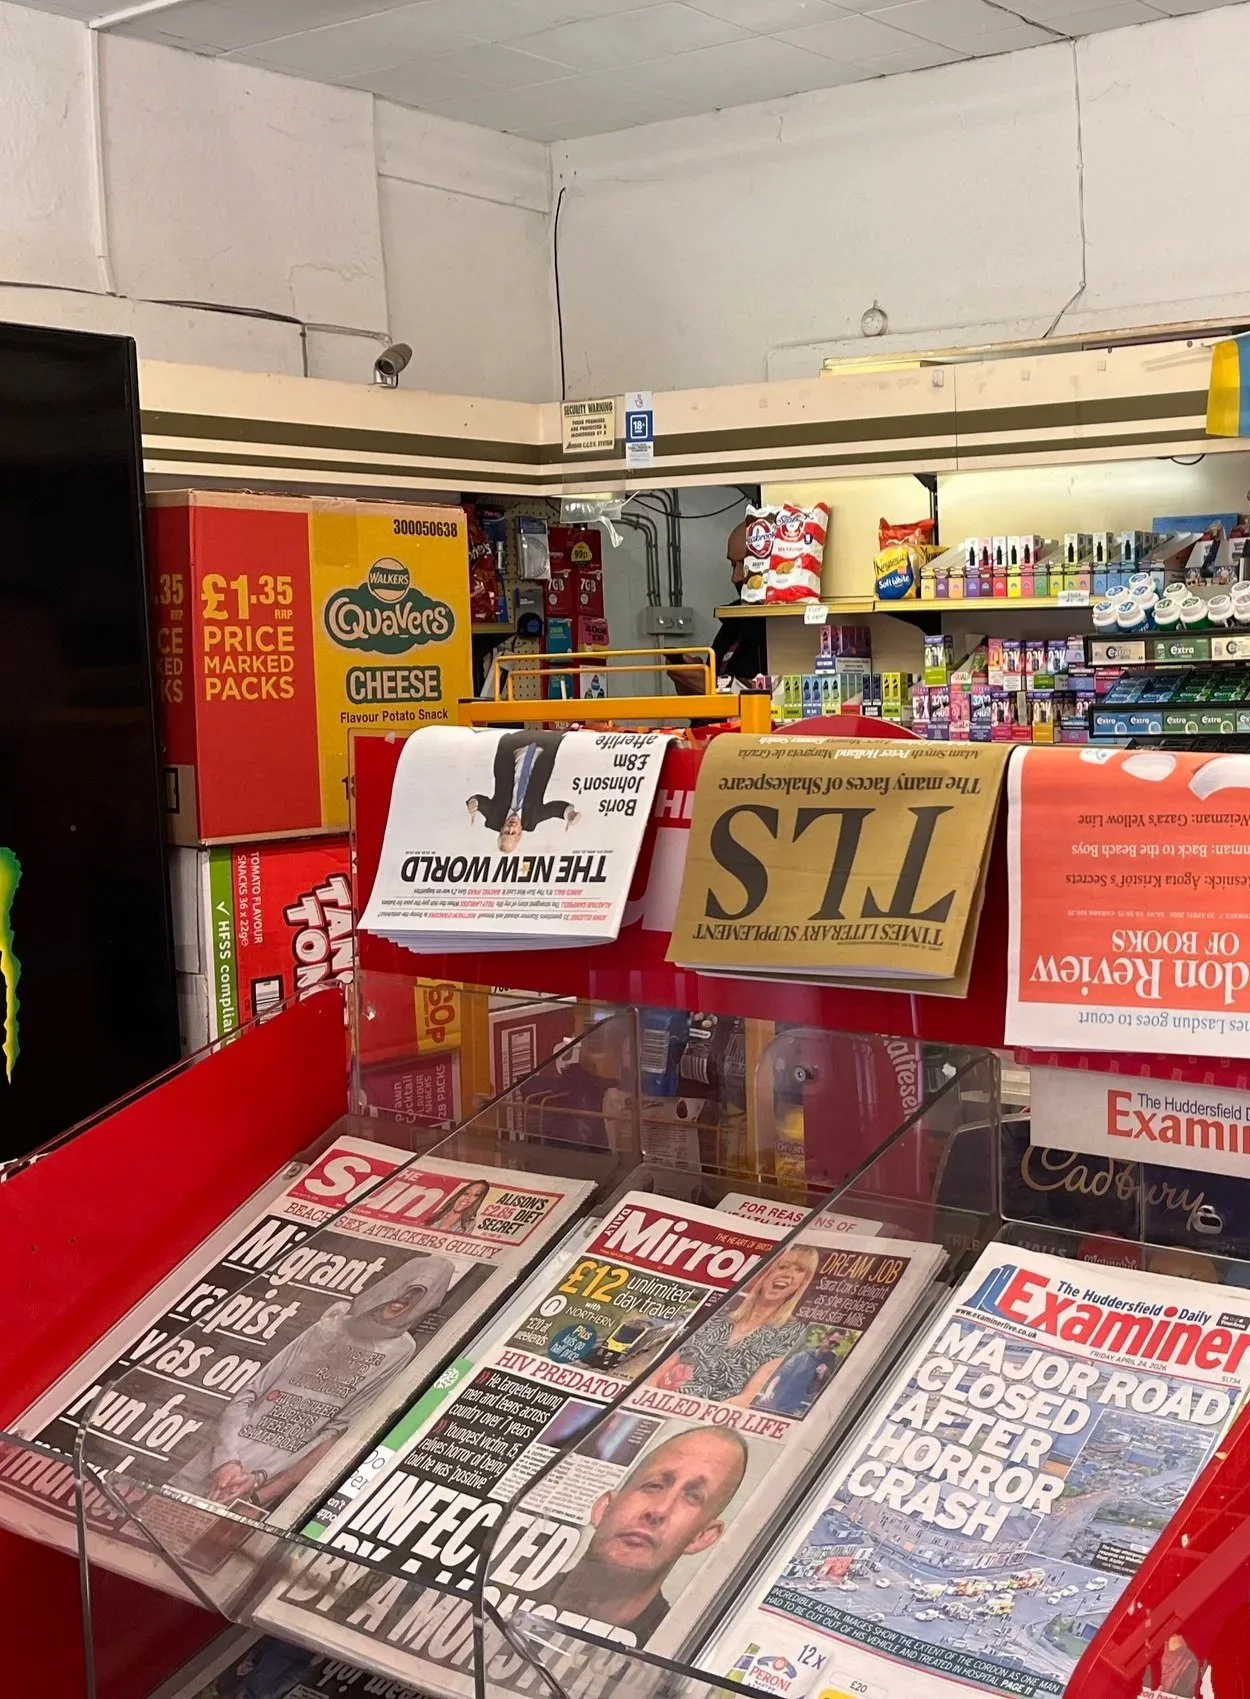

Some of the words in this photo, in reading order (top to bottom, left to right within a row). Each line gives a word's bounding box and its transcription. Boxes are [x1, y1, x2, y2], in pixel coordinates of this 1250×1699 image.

[564, 404, 586, 416] SECURITY
[588, 401, 613, 413] WARNING
[393, 519, 458, 537] 300050638
[369, 571, 409, 585] WALKERS
[581, 578, 596, 592] 7GB
[879, 576, 893, 589] Soft
[892, 574, 910, 586] White
[201, 573, 293, 620] £1.35
[274, 609, 293, 620] RRP
[328, 596, 450, 641] Quavers
[203, 626, 295, 652] PRICE
[1170, 645, 1195, 656] extra
[203, 655, 294, 674] MARKED
[205, 676, 294, 701] PACKS
[350, 669, 438, 701] CHEESE
[340, 710, 384, 723] Flavour
[382, 709, 415, 722] Potato
[418, 708, 449, 720] Snack
[1166, 715, 1187, 726] extra
[1201, 715, 1222, 725] extra
[613, 753, 651, 771] £8m
[572, 774, 645, 794] Johnson's
[718, 773, 823, 794] Shakespeare
[822, 777, 844, 795] of
[845, 776, 890, 795] faces
[893, 773, 944, 794] many
[945, 776, 981, 794] The
[599, 799, 637, 816] Boris
[1078, 814, 1104, 826] Line
[1106, 813, 1146, 826] Yellow
[1147, 813, 1188, 826] Gaza's
[1071, 841, 1098, 857] Boys
[1102, 844, 1137, 858] Beach
[1140, 844, 1160, 858] the
[1162, 844, 1176, 857] to
[1178, 844, 1208, 858] Back
[237, 854, 248, 895] SNACKS
[250, 851, 261, 894] TOMATO
[400, 856, 491, 883] WORLD
[492, 855, 555, 883] NEW
[555, 855, 608, 883] THE
[703, 804, 956, 923] TLS
[239, 896, 248, 910] 36
[252, 896, 263, 944] FLAVOUR
[218, 920, 231, 959] HFSS
[692, 923, 799, 942] SUPPLEMENT
[798, 924, 879, 943] LITERARY
[880, 924, 945, 946] TIMES
[1111, 929, 1199, 954] BOOKS
[1204, 931, 1240, 955] OF
[1029, 955, 1163, 999] Review
[1078, 1011, 1115, 1024] court
[1117, 1013, 1133, 1026] to
[1135, 1012, 1169, 1028] goes
[1172, 1017, 1225, 1035] Lasdun
[435, 1063, 447, 1101] PACKS
[437, 1103, 447, 1118] 28
[1137, 1092, 1162, 1111] The
[1163, 1096, 1243, 1121] Huddersfield
[304, 1154, 446, 1219] Sun
[1020, 1146, 1206, 1232] Cadbury
[495, 1192, 550, 1211] ALISON'S
[479, 1203, 514, 1220] £2.85
[512, 1209, 544, 1225] DIET
[335, 1215, 368, 1234] SEX
[365, 1221, 446, 1250] ATTACKERS
[444, 1239, 503, 1260] GUILTY
[477, 1217, 525, 1236] SECRET
[226, 1219, 388, 1294] Migrant
[603, 1209, 762, 1283] Mirror
[819, 1251, 868, 1281] DREAM
[867, 1259, 904, 1285] JOB
[558, 1259, 631, 1304] £12
[626, 1276, 697, 1304] unlimited
[613, 1290, 648, 1315] day
[1056, 1279, 1081, 1297] The
[1081, 1288, 1164, 1318] Huddersfield
[1177, 1306, 1213, 1326] Daily
[566, 1306, 617, 1329] NORTHERN
[953, 1306, 1040, 1340] www.examinerlive.co.uk
[495, 1350, 529, 1371] HIV
[936, 1321, 1102, 1400] MAJOR
[1098, 1371, 1232, 1427] ROAD
[915, 1356, 1092, 1436] CLOSED
[699, 1401, 742, 1429] FOR
[739, 1413, 791, 1441] LIFE
[889, 1389, 1054, 1470] AFTER
[867, 1423, 1066, 1516] HORROR
[846, 1460, 1012, 1544] CRASH
[347, 1469, 582, 1594] INFECTED
[796, 1642, 827, 1671] 12x
[748, 1665, 792, 1692] PERONI
[848, 1681, 868, 1694] £20
